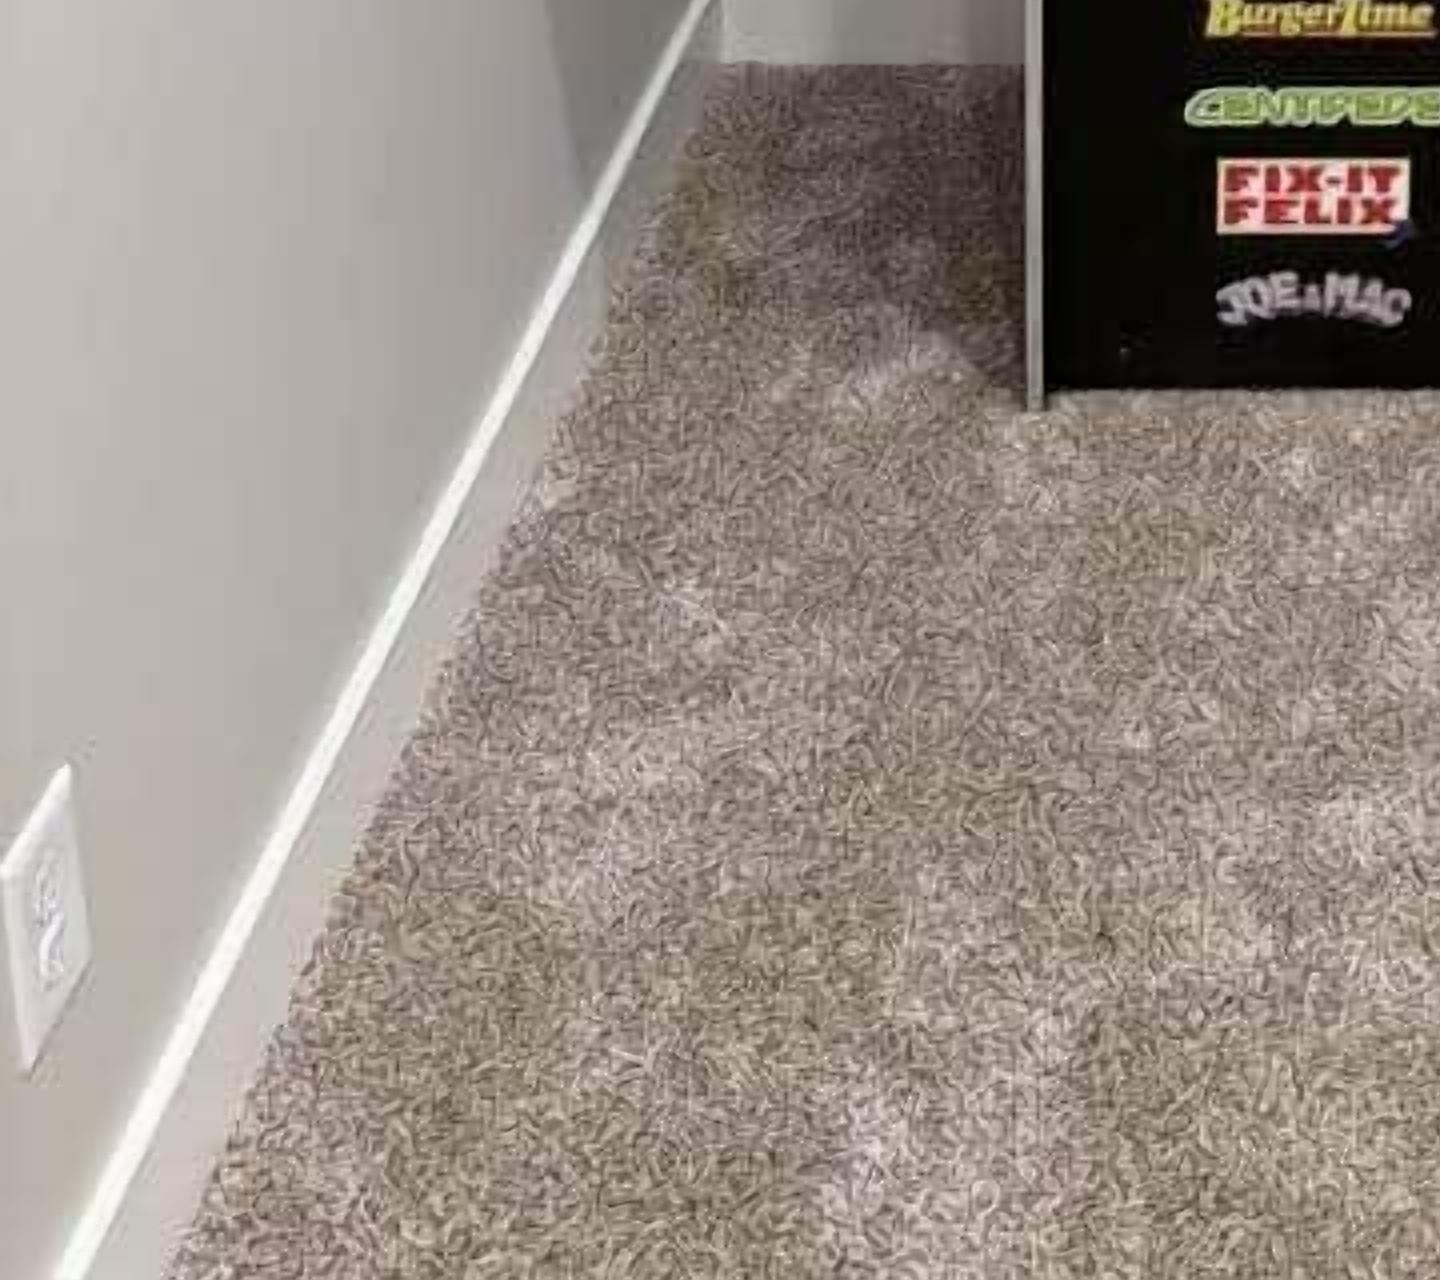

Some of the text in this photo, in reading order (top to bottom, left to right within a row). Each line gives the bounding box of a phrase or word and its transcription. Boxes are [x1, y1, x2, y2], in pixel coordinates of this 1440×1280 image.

[1223, 164, 1401, 193] FIX-IT
[1223, 197, 1397, 225] FELIX
[1215, 270, 1300, 326] JOE
[1323, 271, 1413, 326] MAC
